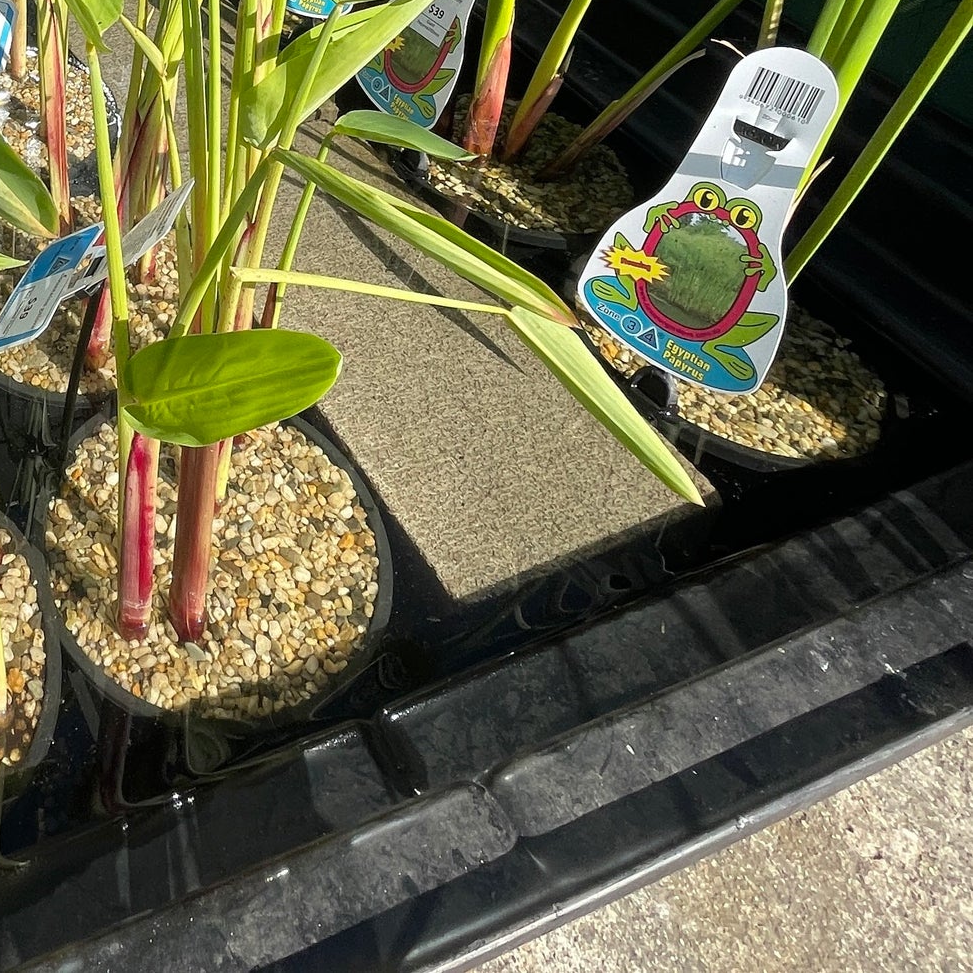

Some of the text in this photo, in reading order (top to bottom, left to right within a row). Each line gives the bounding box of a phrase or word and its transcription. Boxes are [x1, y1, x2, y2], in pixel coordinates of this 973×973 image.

[299, 0, 322, 14] Papyrus
[428, 3, 445, 20] $39
[596, 302, 622, 321] Zone
[627, 320, 637, 331] 3
[644, 329, 654, 343] 4
[665, 339, 711, 372] Egyptian
[662, 350, 706, 381] Papyrus
